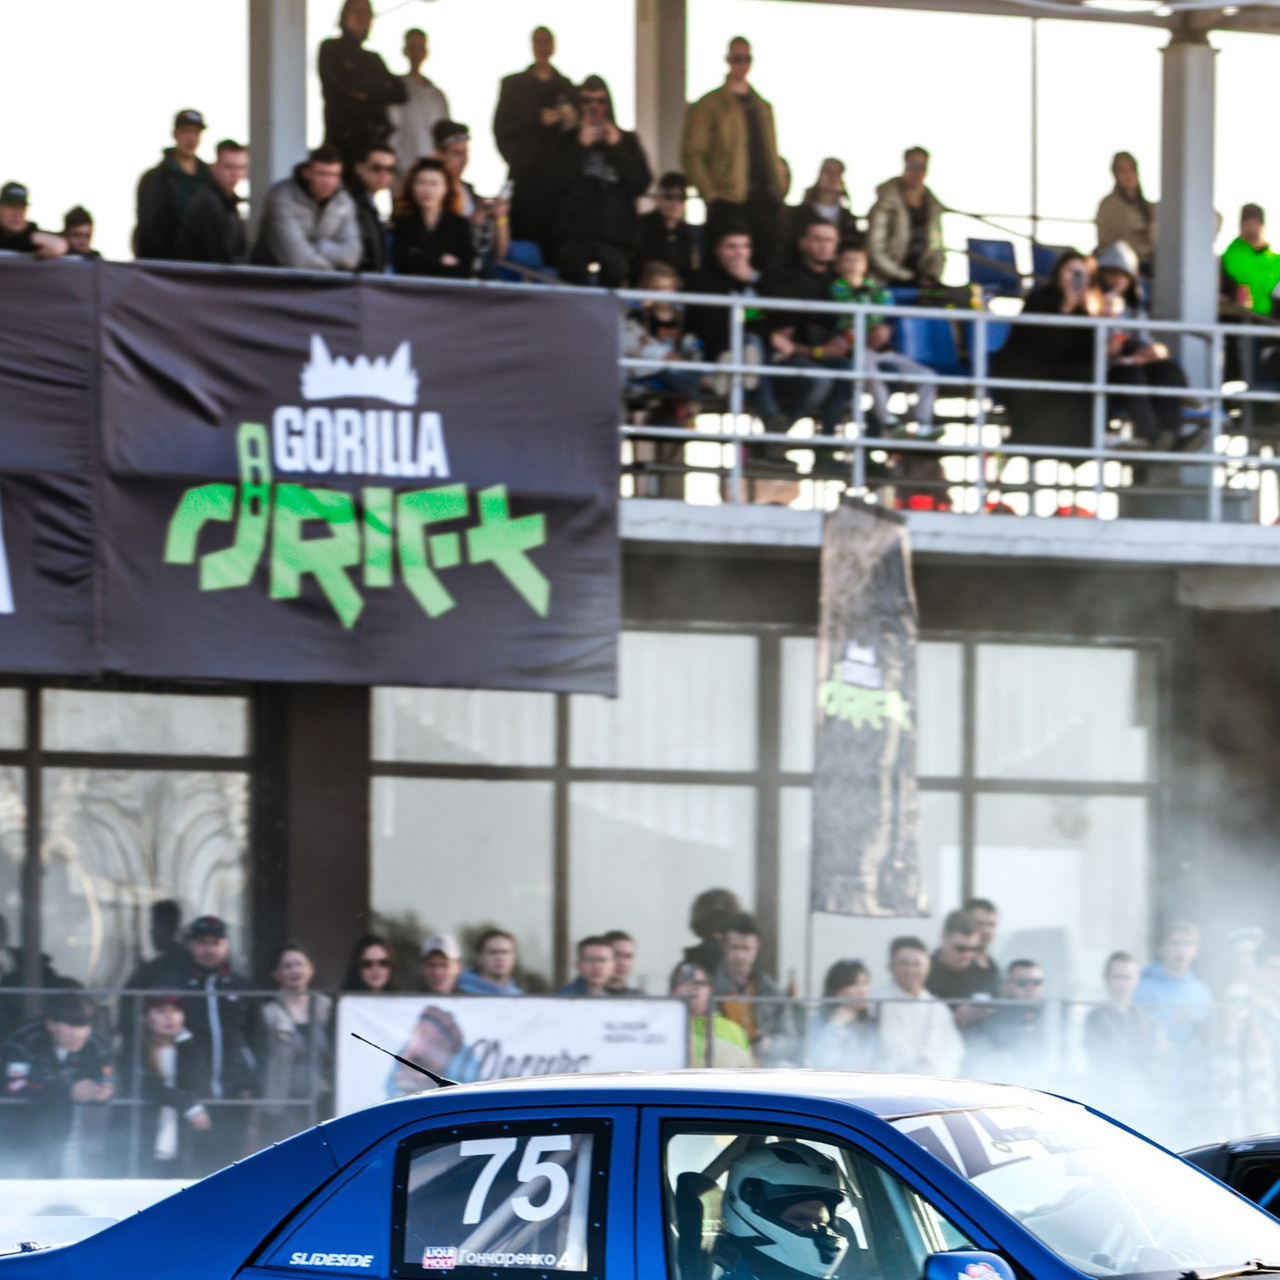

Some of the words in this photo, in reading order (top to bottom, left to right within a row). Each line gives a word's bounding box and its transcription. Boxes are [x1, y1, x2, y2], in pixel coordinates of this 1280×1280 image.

[273, 405, 450, 477] GORILLA
[459, 1134, 572, 1224] 75
[289, 1252, 374, 1267] SLIDESIDE
